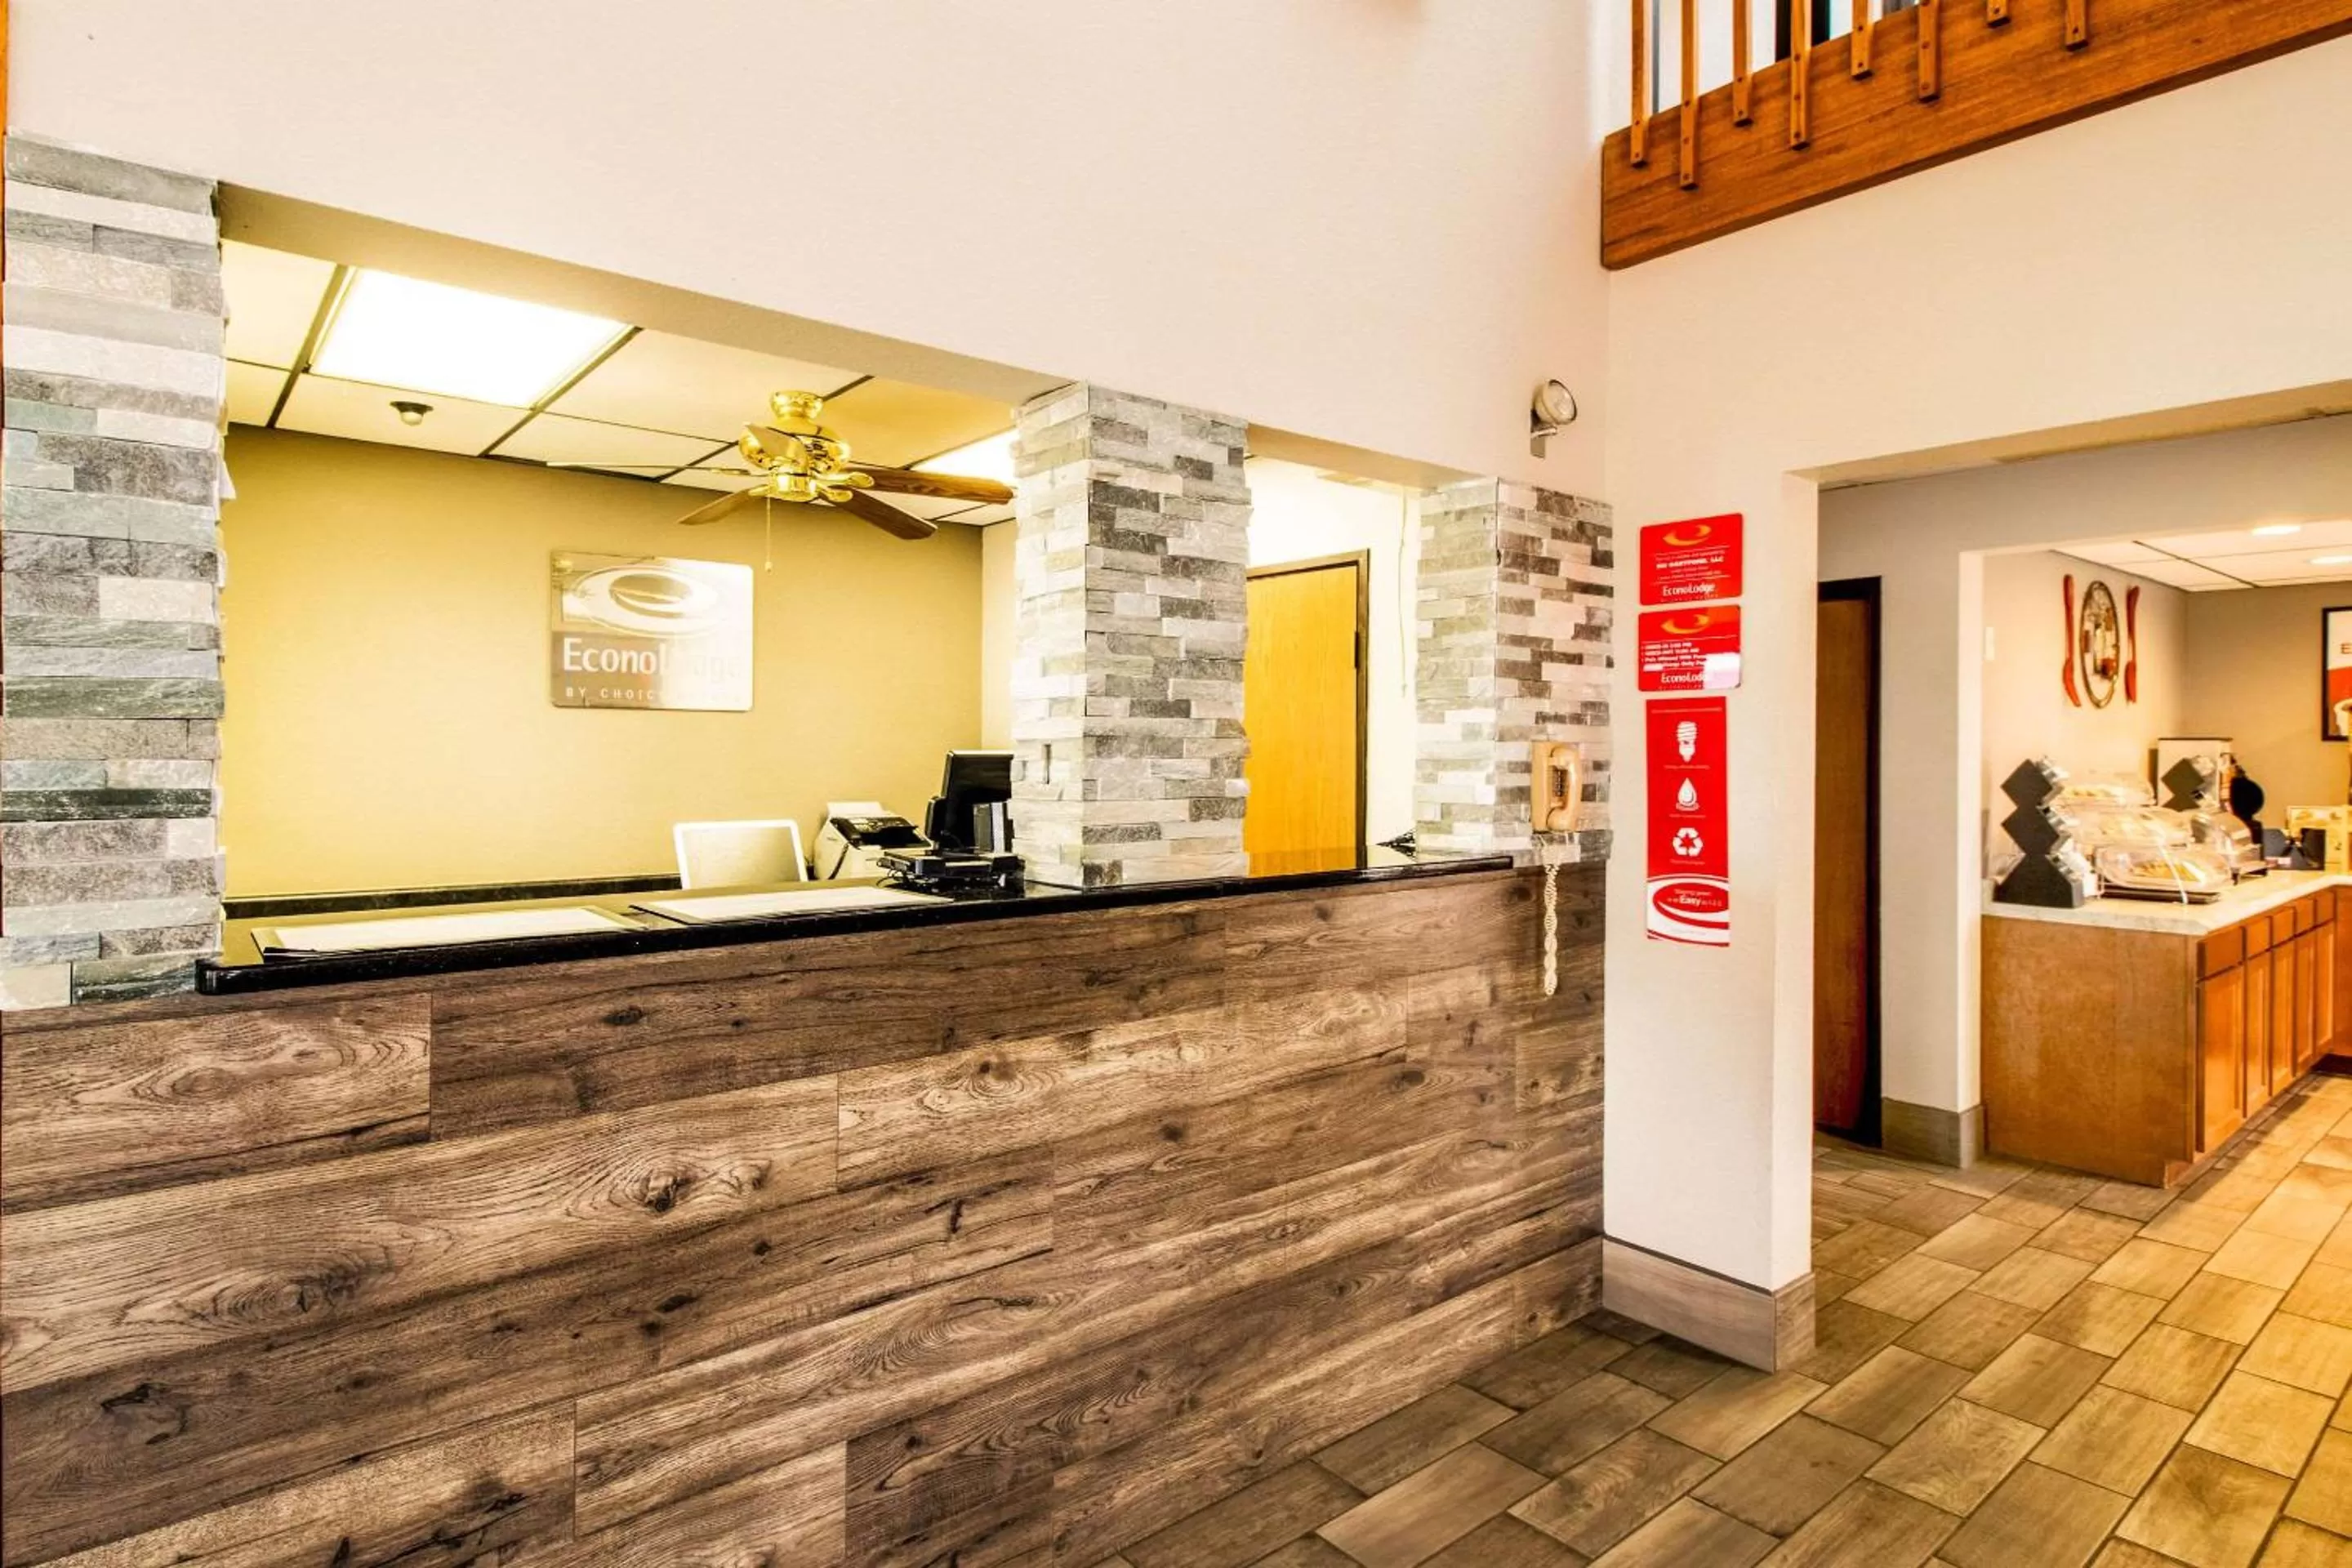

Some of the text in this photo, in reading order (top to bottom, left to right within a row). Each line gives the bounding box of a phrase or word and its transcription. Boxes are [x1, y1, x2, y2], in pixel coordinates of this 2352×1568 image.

[1662, 582, 1715, 597] EconoLodge
[1661, 671, 1708, 684] EconoLod
[565, 687, 656, 700] BY CHOIC
